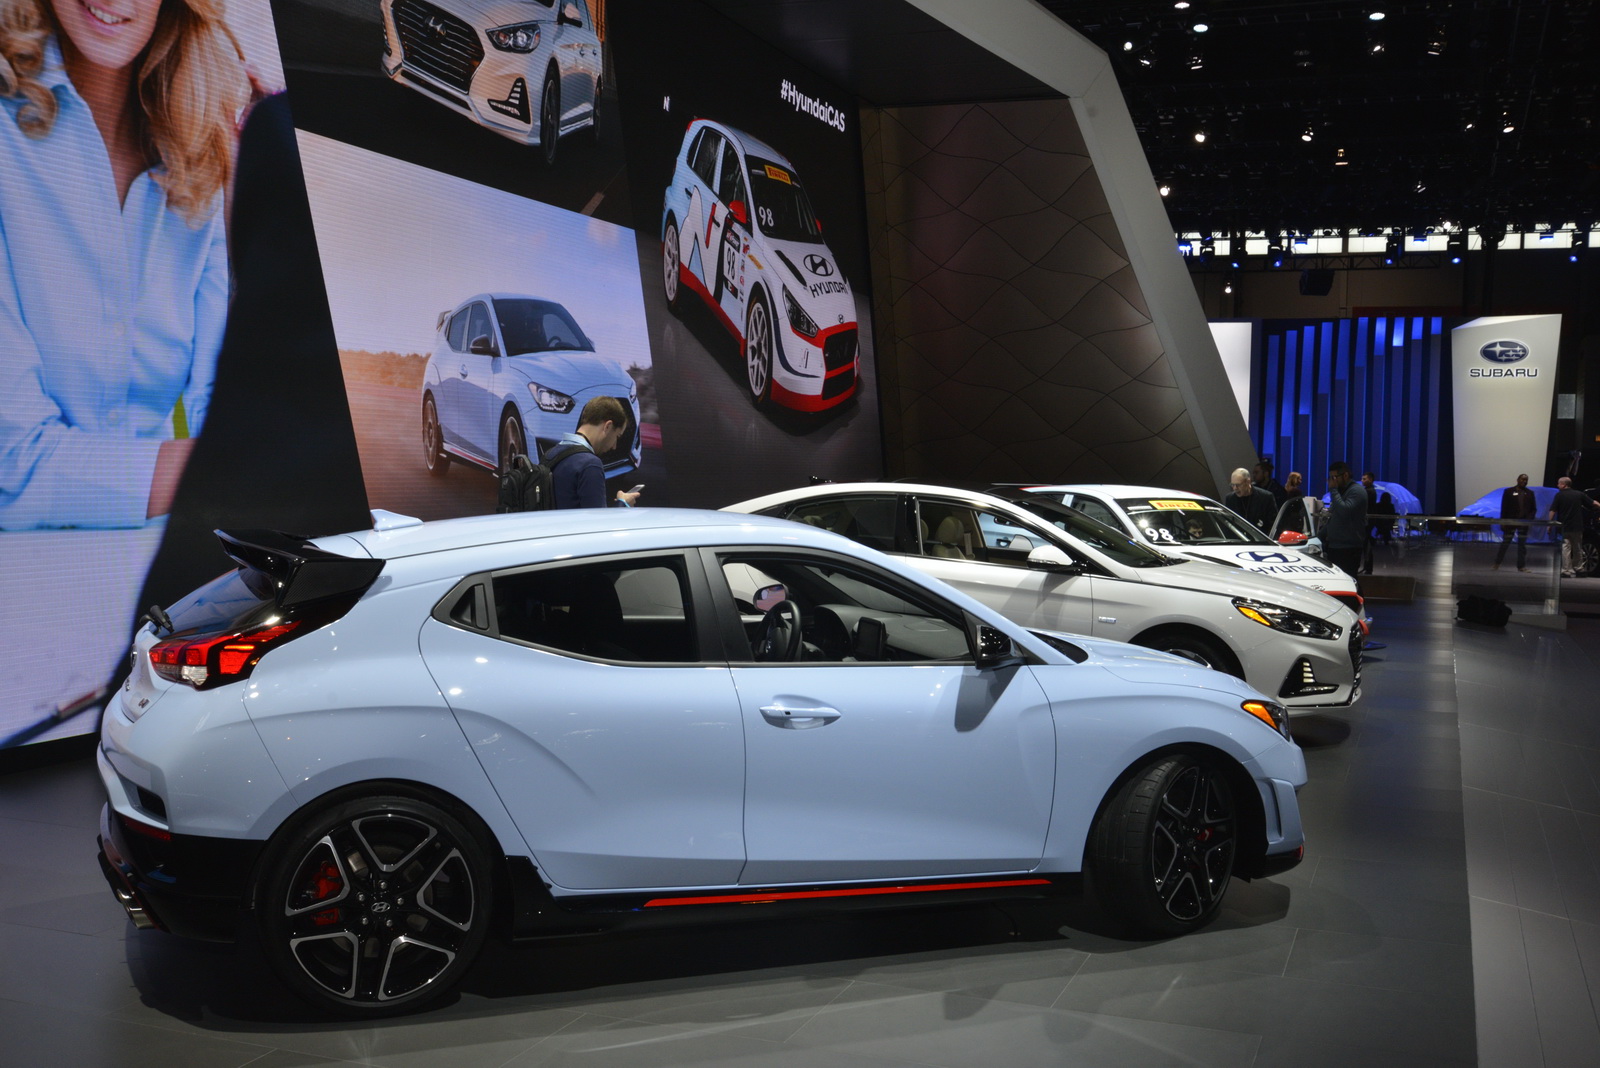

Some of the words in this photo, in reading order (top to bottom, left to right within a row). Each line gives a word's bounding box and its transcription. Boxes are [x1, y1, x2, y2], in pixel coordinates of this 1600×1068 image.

[780, 78, 845, 133] #HyundaiCAS
[758, 205, 774, 227] 98
[726, 247, 736, 281] 98
[809, 280, 848, 298] HYUNDAI
[1469, 368, 1538, 378] SUBARU
[1144, 527, 1174, 542] 98
[1249, 564, 1336, 576] HYUNDAI
